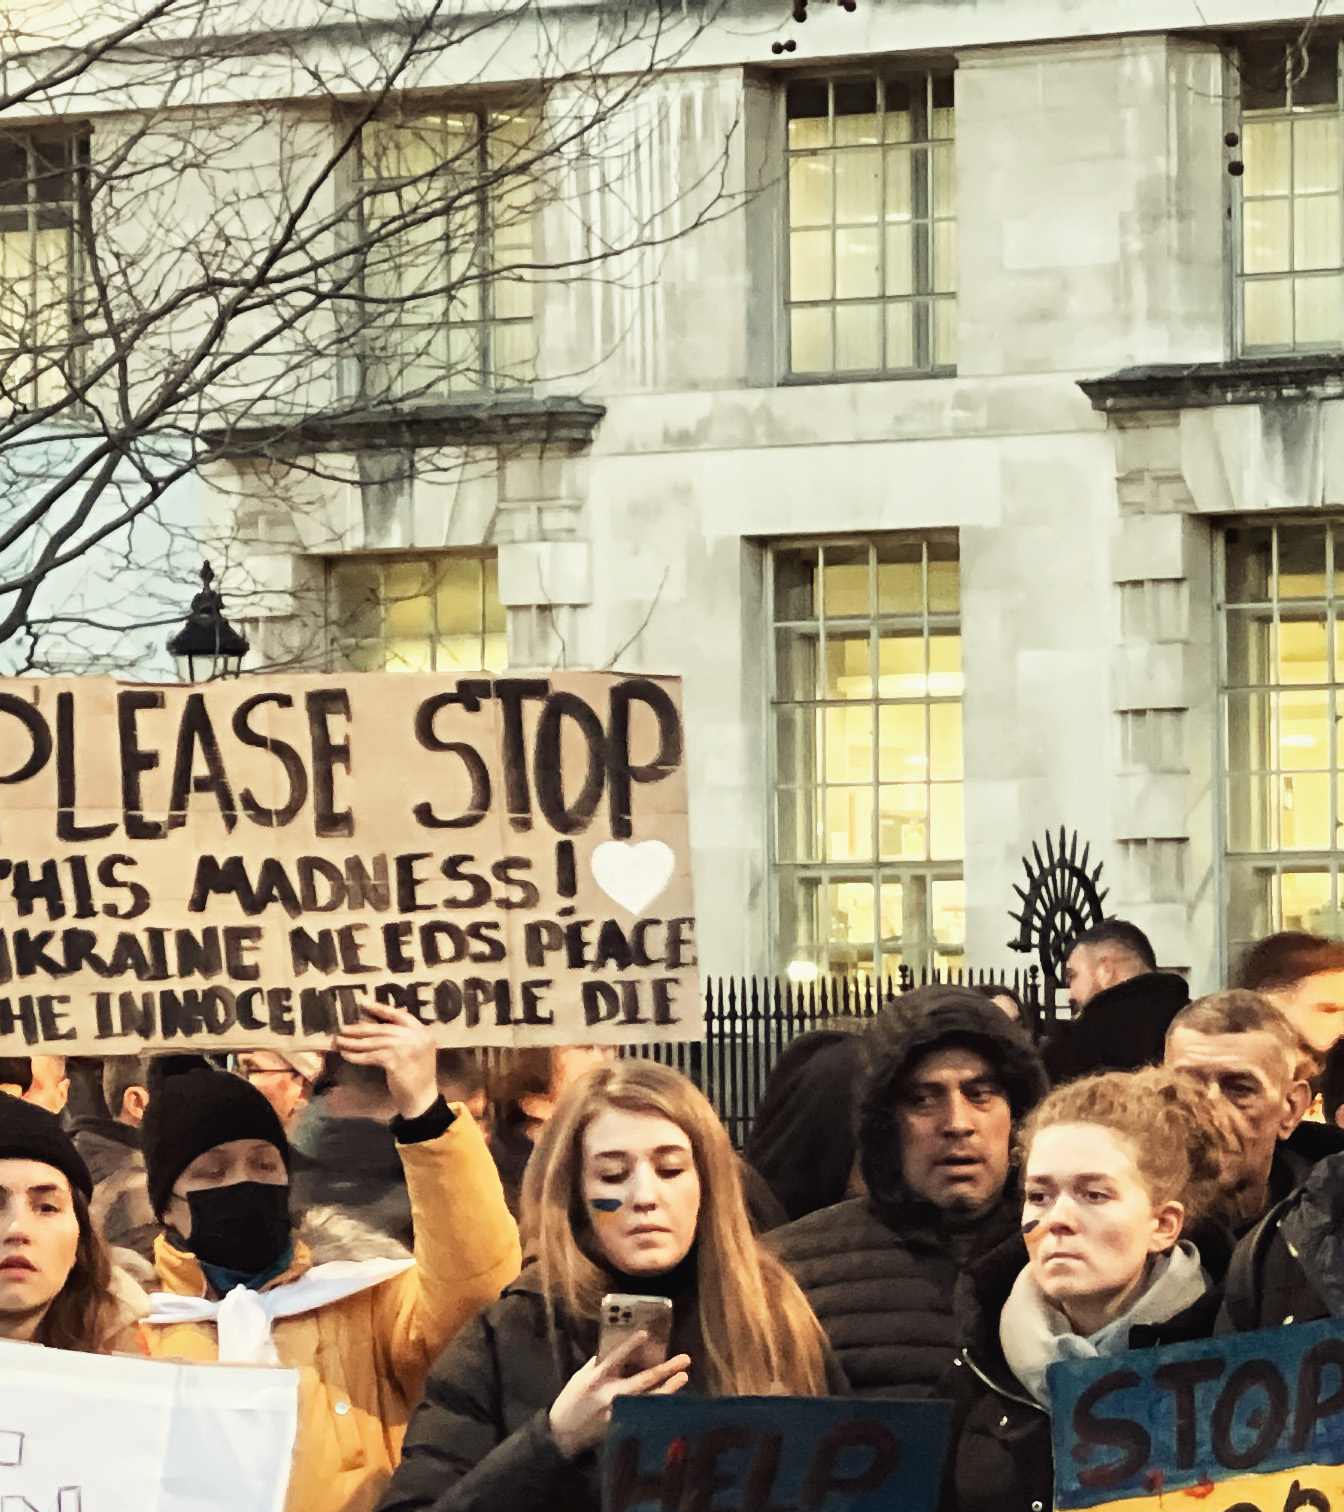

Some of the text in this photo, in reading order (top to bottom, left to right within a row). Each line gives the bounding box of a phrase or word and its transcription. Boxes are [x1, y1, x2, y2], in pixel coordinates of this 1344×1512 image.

[413, 676, 683, 841] STOP
[287, 919, 509, 977] NEEDS
[524, 916, 697, 972] PEACE
[93, 982, 368, 1042] INNOCENT
[581, 978, 683, 1026] DIE
